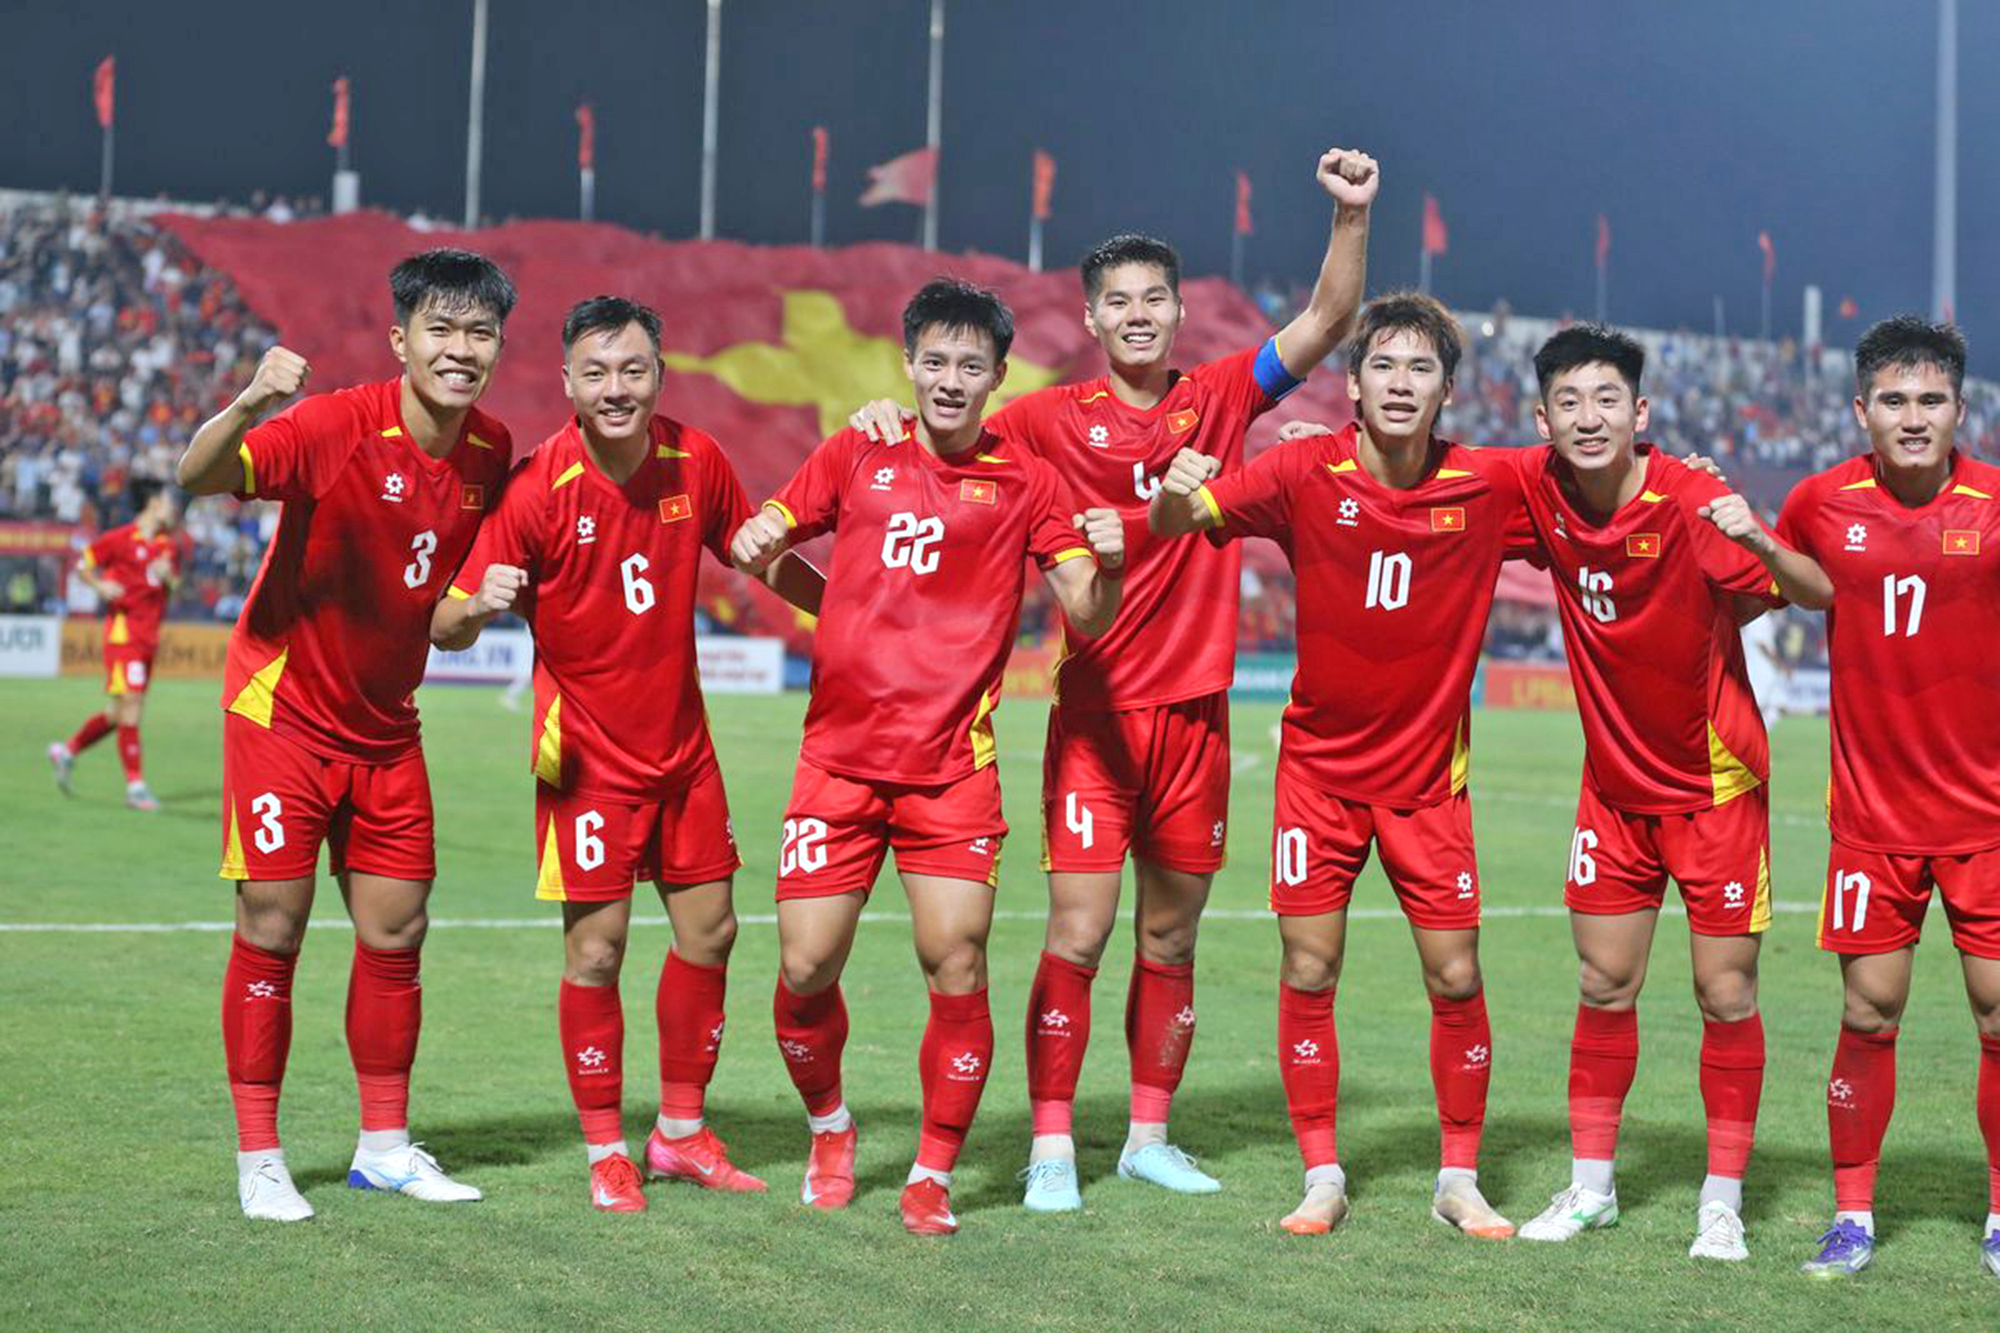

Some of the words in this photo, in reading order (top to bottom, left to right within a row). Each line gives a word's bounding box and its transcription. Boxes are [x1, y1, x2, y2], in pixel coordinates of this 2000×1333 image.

[1133, 461, 1161, 500] 4
[403, 530, 437, 589] 3
[881, 512, 945, 575] 22
[621, 553, 655, 615] 6
[1365, 551, 1412, 610] 10
[1579, 566, 1616, 623] 16
[1884, 574, 1926, 637] 17
[252, 792, 285, 854] 3
[576, 810, 604, 871] 6
[780, 817, 827, 877] 22
[1066, 791, 1093, 849] 4
[1276, 827, 1307, 886] 10
[1568, 826, 1598, 886] 16
[1833, 870, 1870, 932] 17
